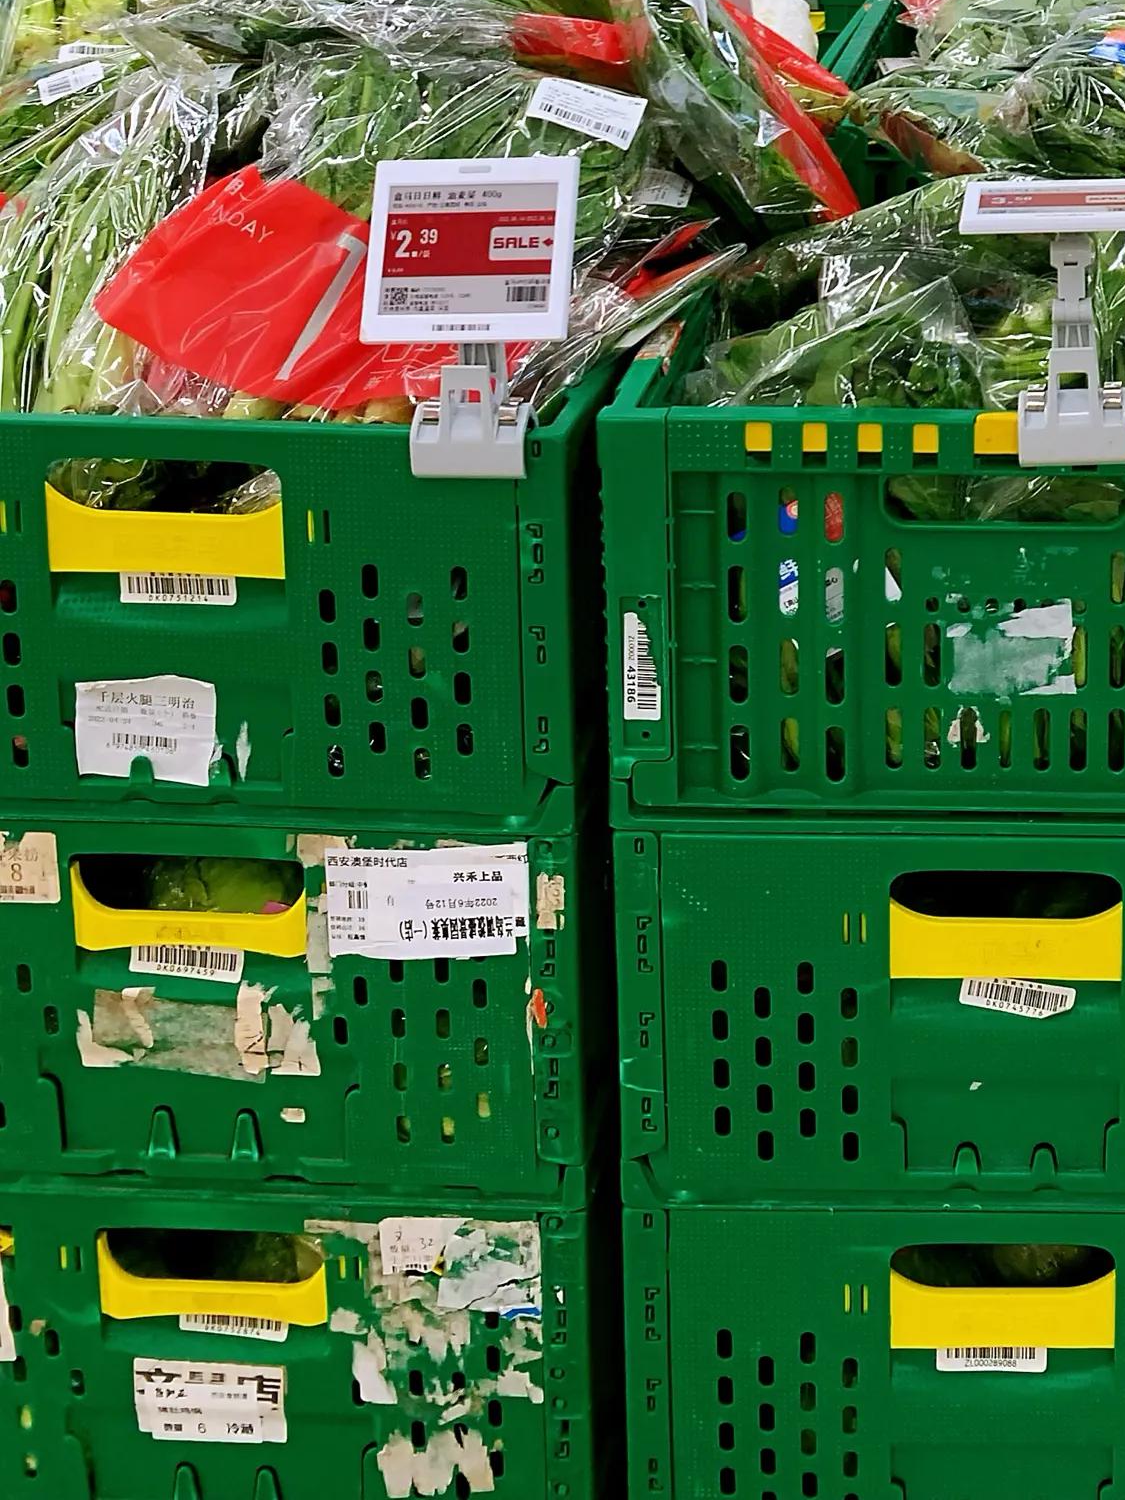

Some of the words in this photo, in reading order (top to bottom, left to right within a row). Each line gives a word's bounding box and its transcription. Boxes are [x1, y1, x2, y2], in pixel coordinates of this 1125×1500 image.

[492, 236, 540, 249] SALE
[626, 664, 636, 703] 43186
[327, 856, 409, 868] 西安澳堡时代店
[10, 862, 23, 882] 8
[197, 1422, 207, 1434] 6
